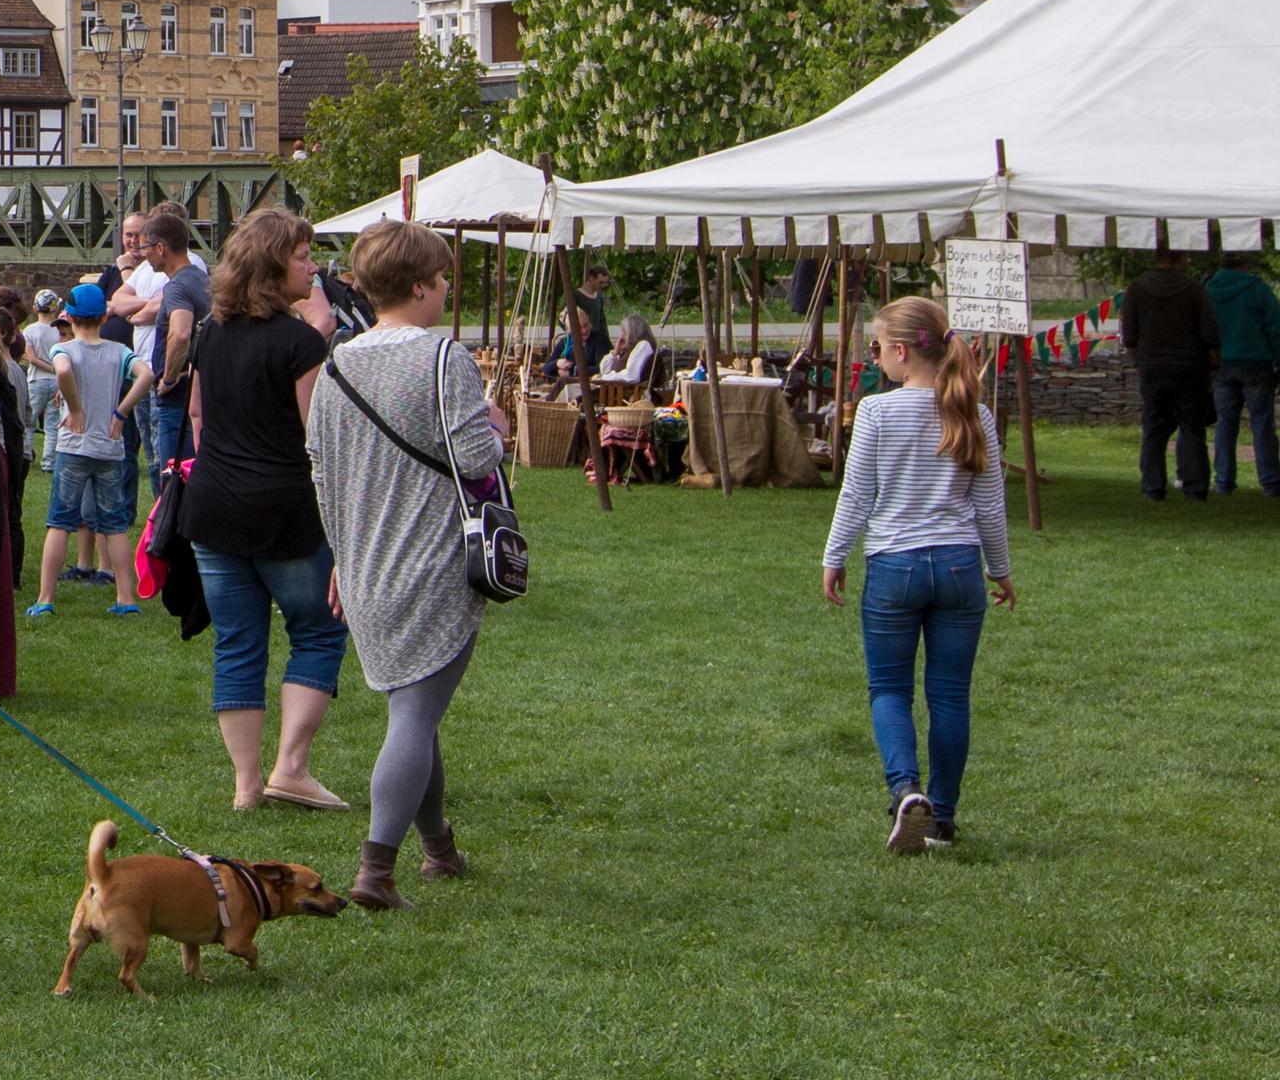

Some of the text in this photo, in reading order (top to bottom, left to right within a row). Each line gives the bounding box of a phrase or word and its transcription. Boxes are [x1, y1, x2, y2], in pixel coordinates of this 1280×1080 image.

[1006, 267, 1024, 283] Taler
[949, 282, 954, 292] 7
[985, 283, 1004, 297] 200
[1004, 284, 1023, 299] Taler
[960, 315, 984, 331] Wurf
[1007, 316, 1027, 332] Taler
